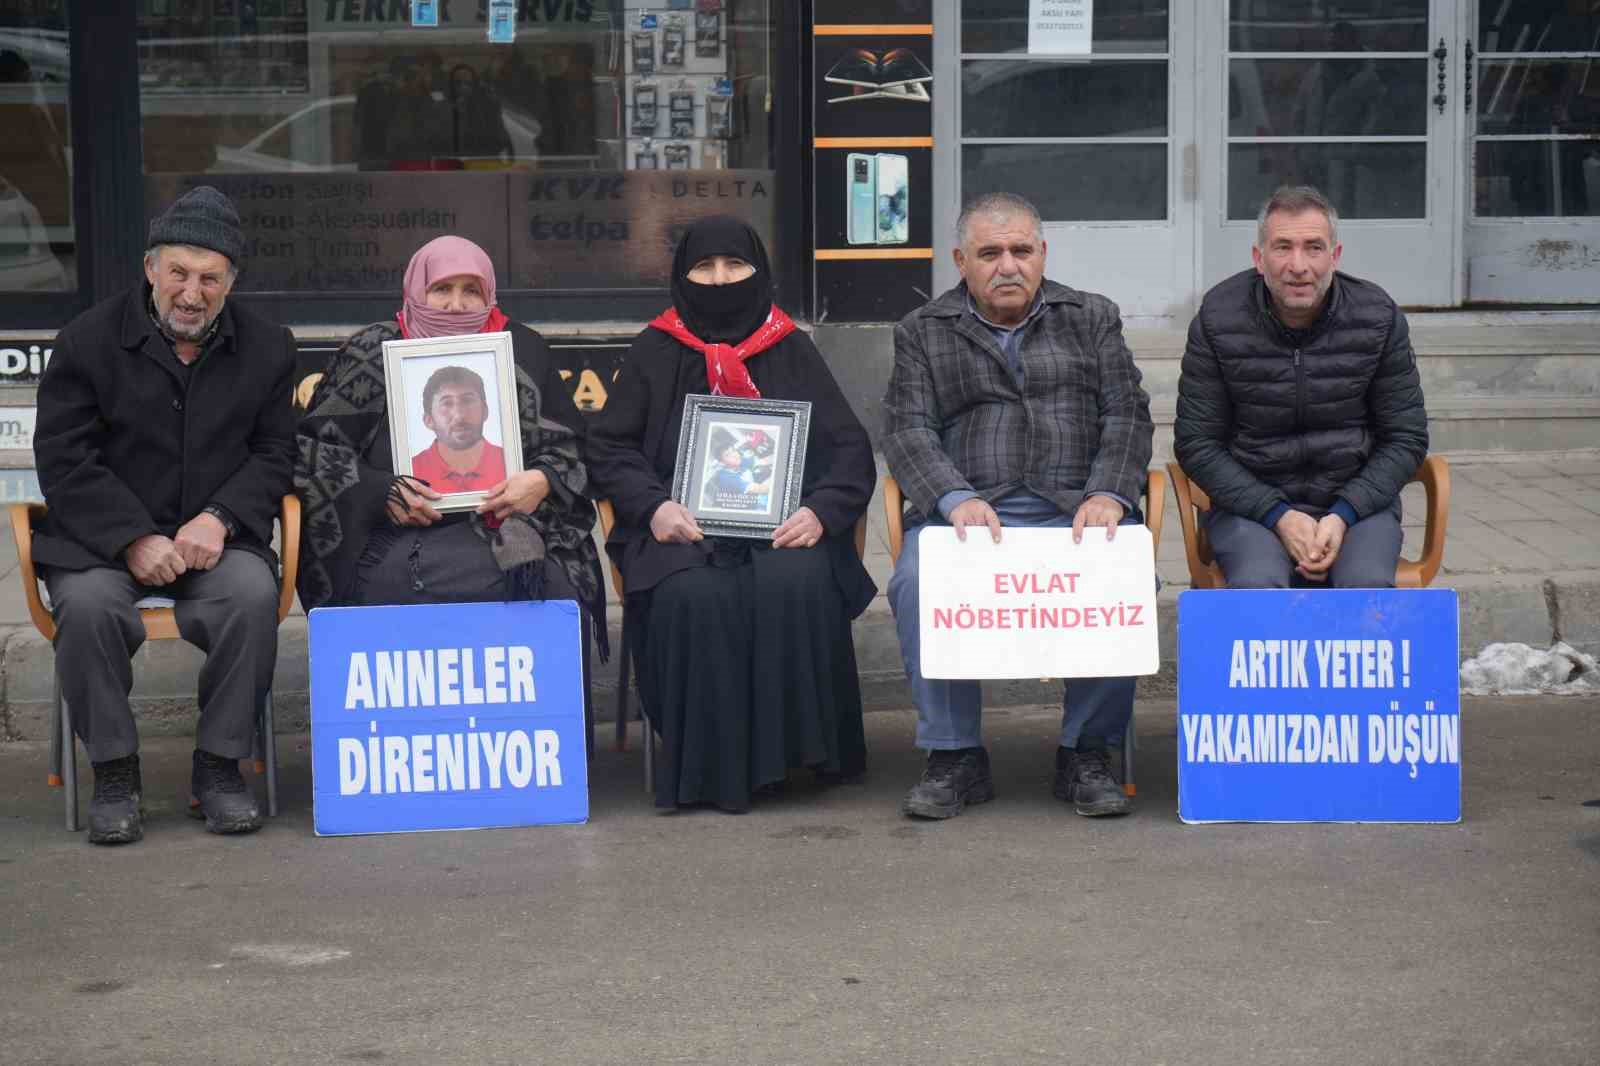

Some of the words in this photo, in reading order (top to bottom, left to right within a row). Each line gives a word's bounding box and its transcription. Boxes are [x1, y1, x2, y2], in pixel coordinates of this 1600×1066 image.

[324, 0, 452, 22] TEKNK
[529, 176, 628, 201] KVK
[672, 180, 767, 198] DELTA
[994, 573, 1080, 594] EVLAT
[934, 601, 1144, 630] NÖBETİNDEYİZ
[345, 646, 536, 709] ANNELER
[1229, 640, 1309, 688] ARTIK
[1315, 640, 1394, 688] YETER
[1181, 714, 1359, 763] YAKAMIZDAN
[1368, 700, 1459, 779] DÜŞÜN
[338, 716, 562, 795] DİRENİYOR
